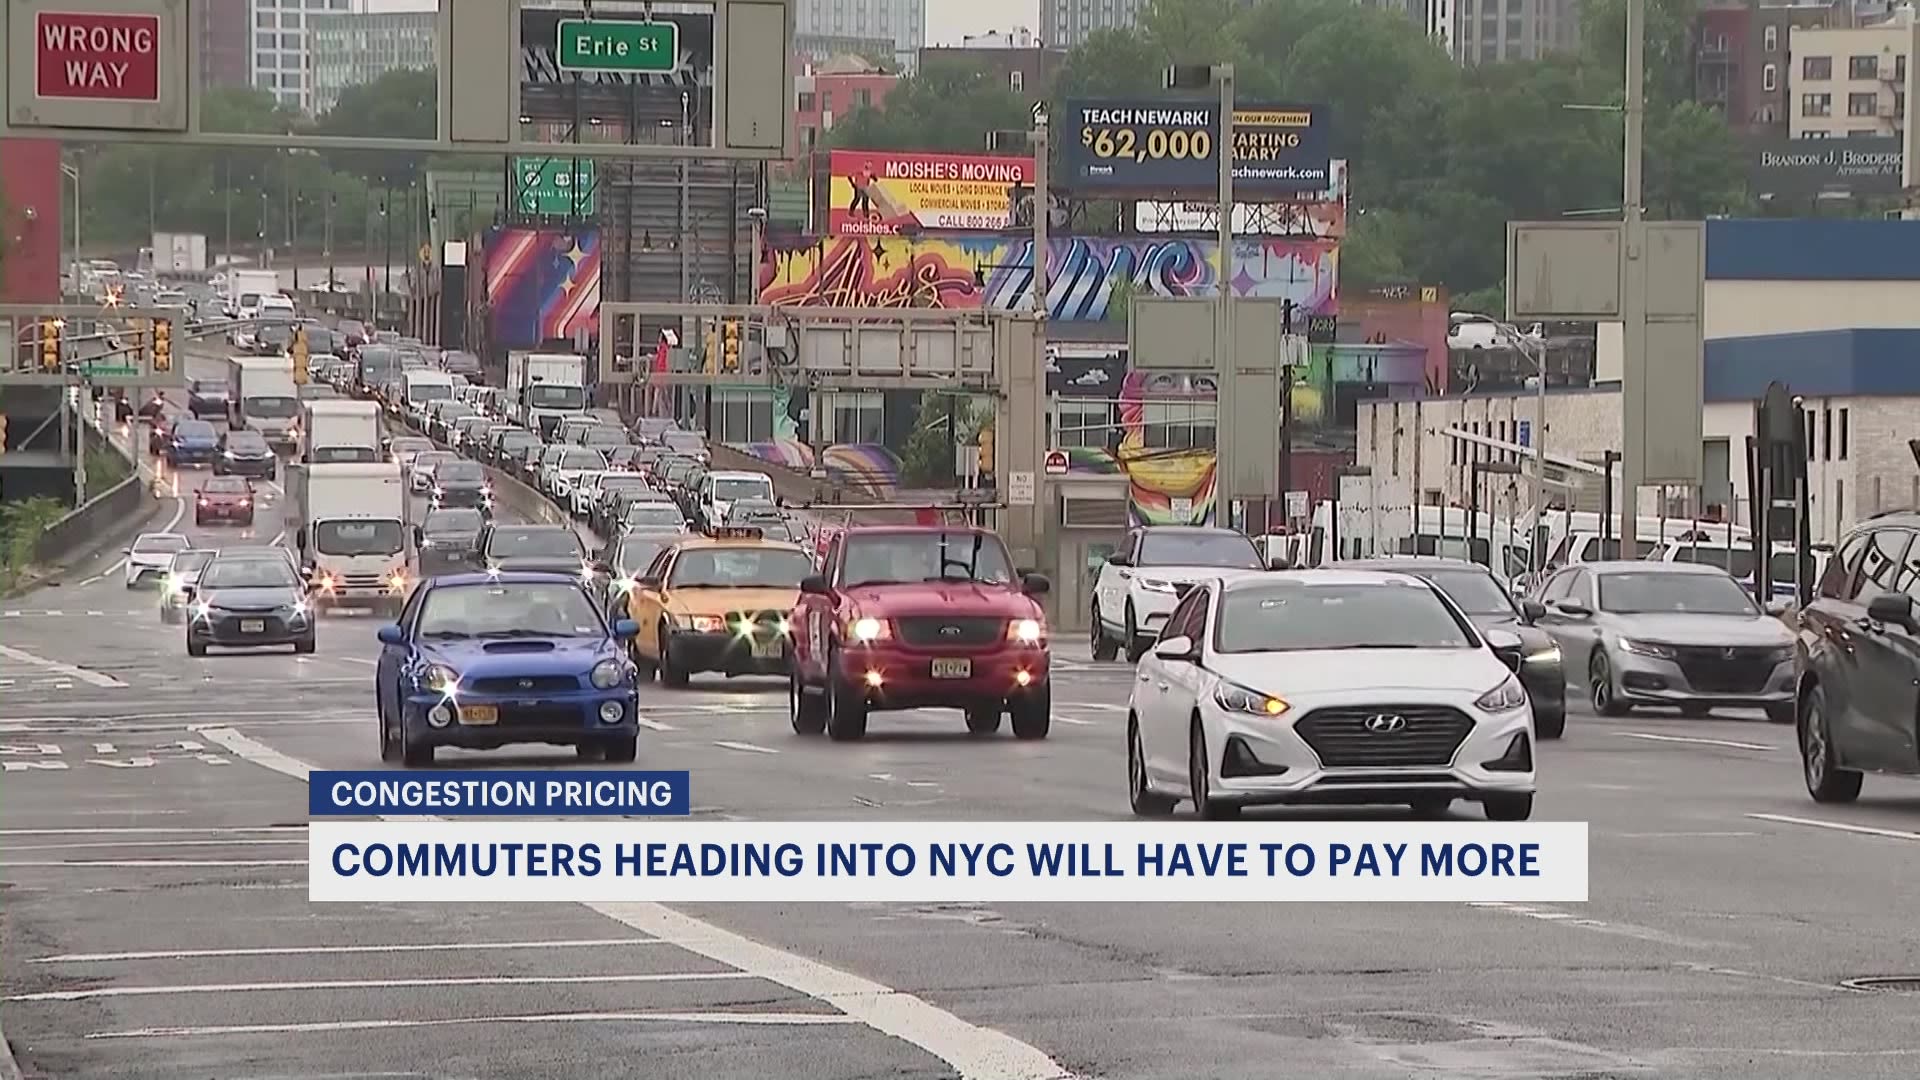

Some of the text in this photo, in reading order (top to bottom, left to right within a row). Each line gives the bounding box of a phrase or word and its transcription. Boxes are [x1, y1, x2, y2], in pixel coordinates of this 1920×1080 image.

[44, 24, 152, 53] WRONG
[576, 35, 658, 56] Erie St
[65, 60, 129, 88] WAY
[1082, 109, 1209, 126] TEACH NEWARK!
[1081, 126, 1211, 163] $62,000
[1232, 133, 1300, 147] TARTING
[1232, 147, 1280, 160] ALARY
[1824, 149, 1838, 165] J.
[885, 160, 1022, 181] MOISHE'S MOVING
[1232, 165, 1324, 178] achnewark.com
[841, 220, 900, 234] moishes.c
[939, 215, 964, 227] CALL
